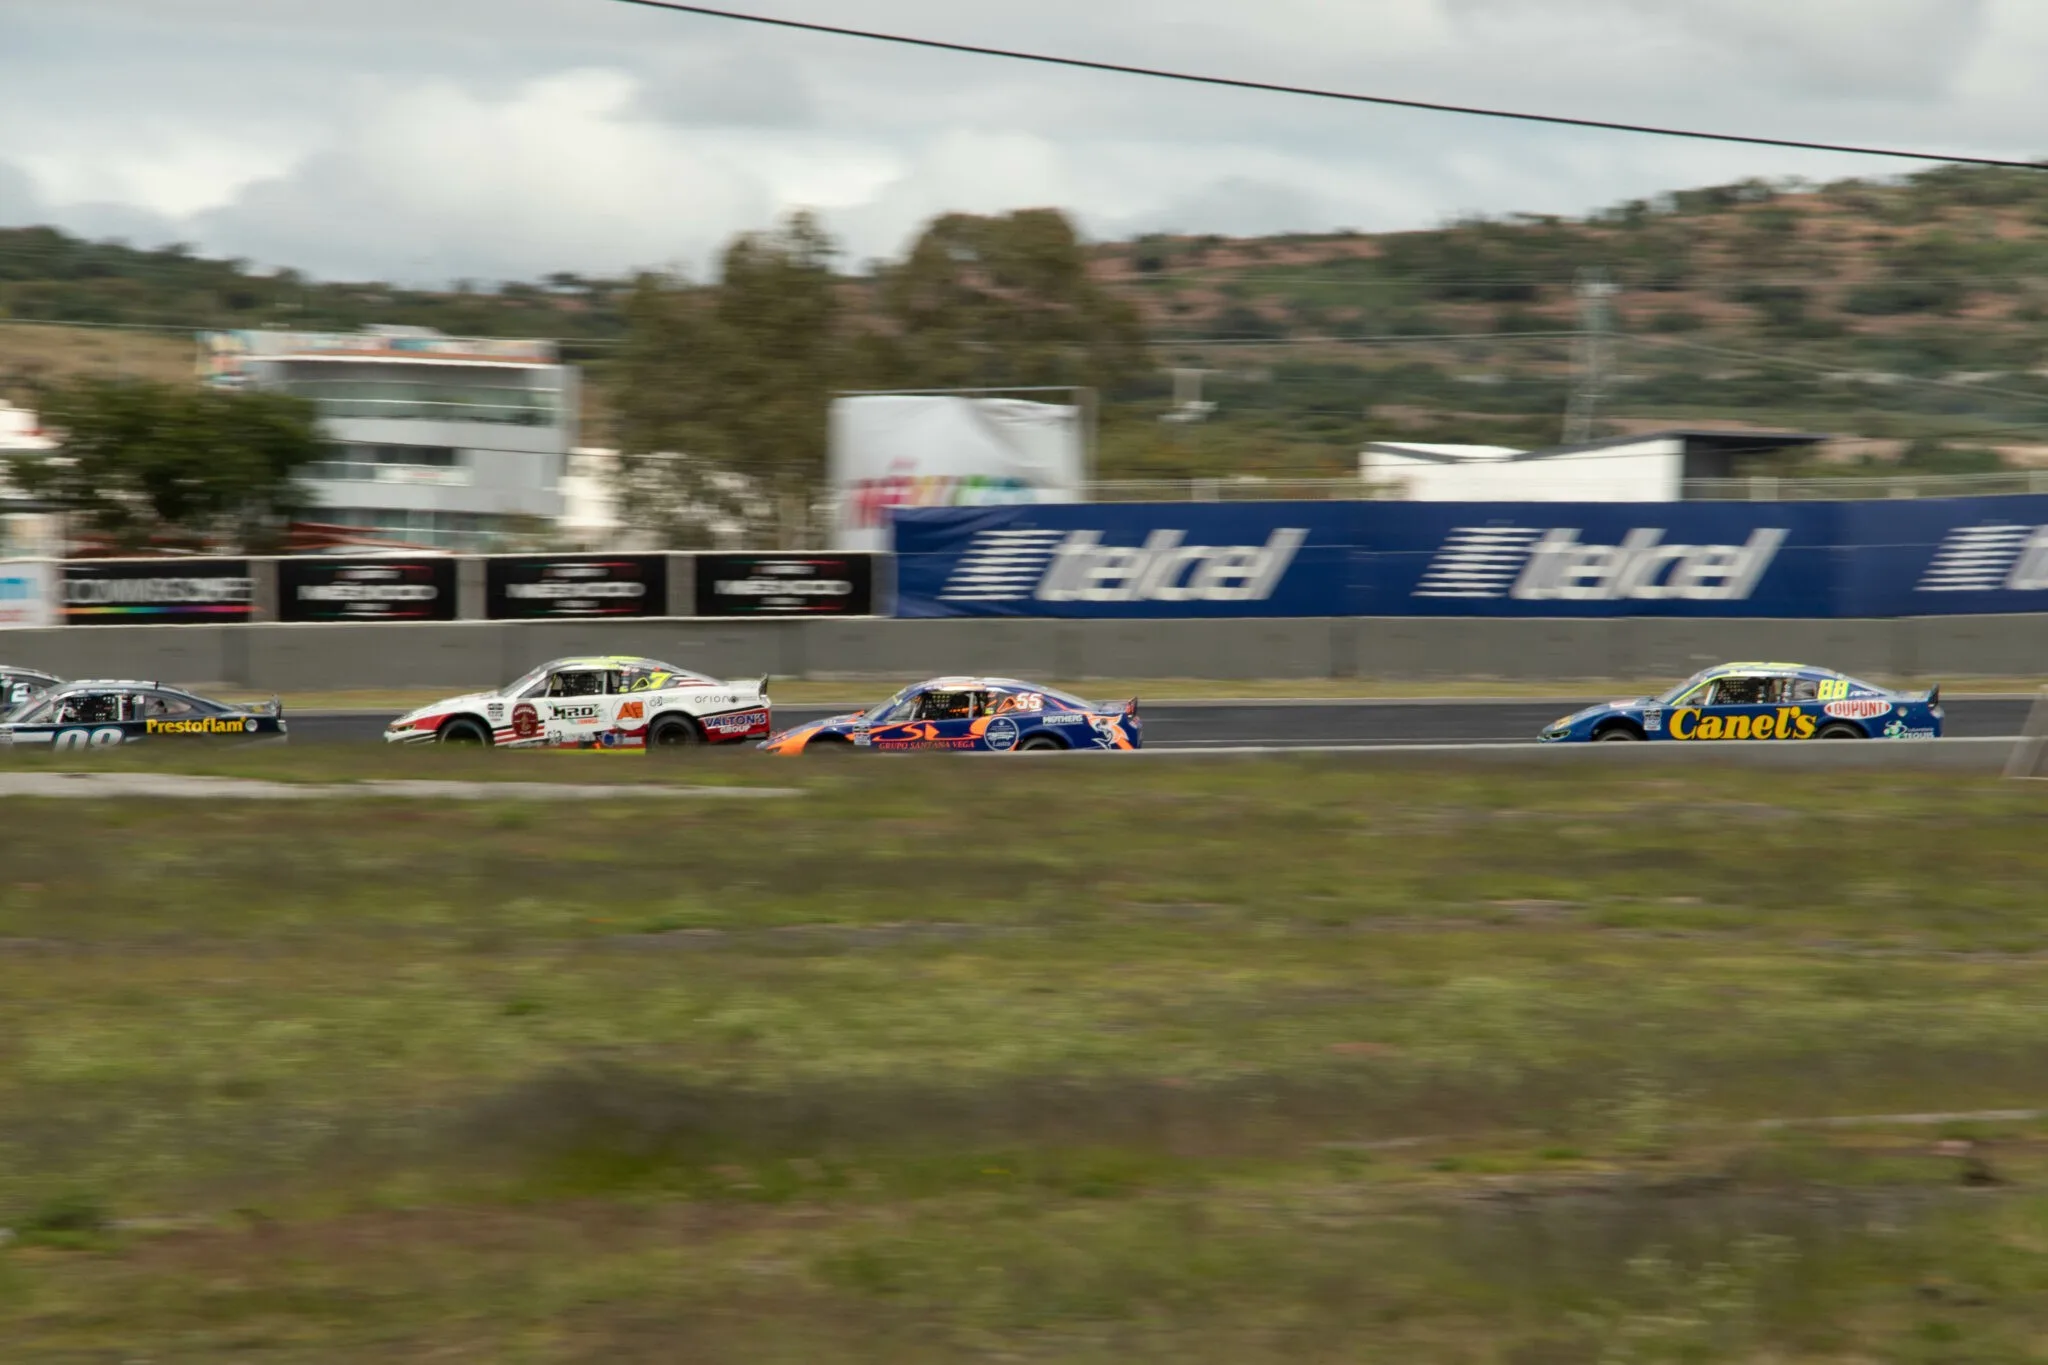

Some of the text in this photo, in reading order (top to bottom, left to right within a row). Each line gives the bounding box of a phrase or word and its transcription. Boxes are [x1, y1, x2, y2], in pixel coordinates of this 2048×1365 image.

[1034, 528, 1311, 601] telcel
[1508, 528, 1790, 600] telcel
[649, 671, 672, 689] 7
[1817, 679, 1848, 700] 88
[1015, 692, 1043, 711] 55
[146, 716, 244, 734] Prestoflam
[703, 713, 765, 728] VALTON'S
[1043, 715, 1083, 725] MOTHERS
[1668, 705, 1817, 741] Canel's
[878, 740, 974, 750] GRUPO SANTANA VEGA
